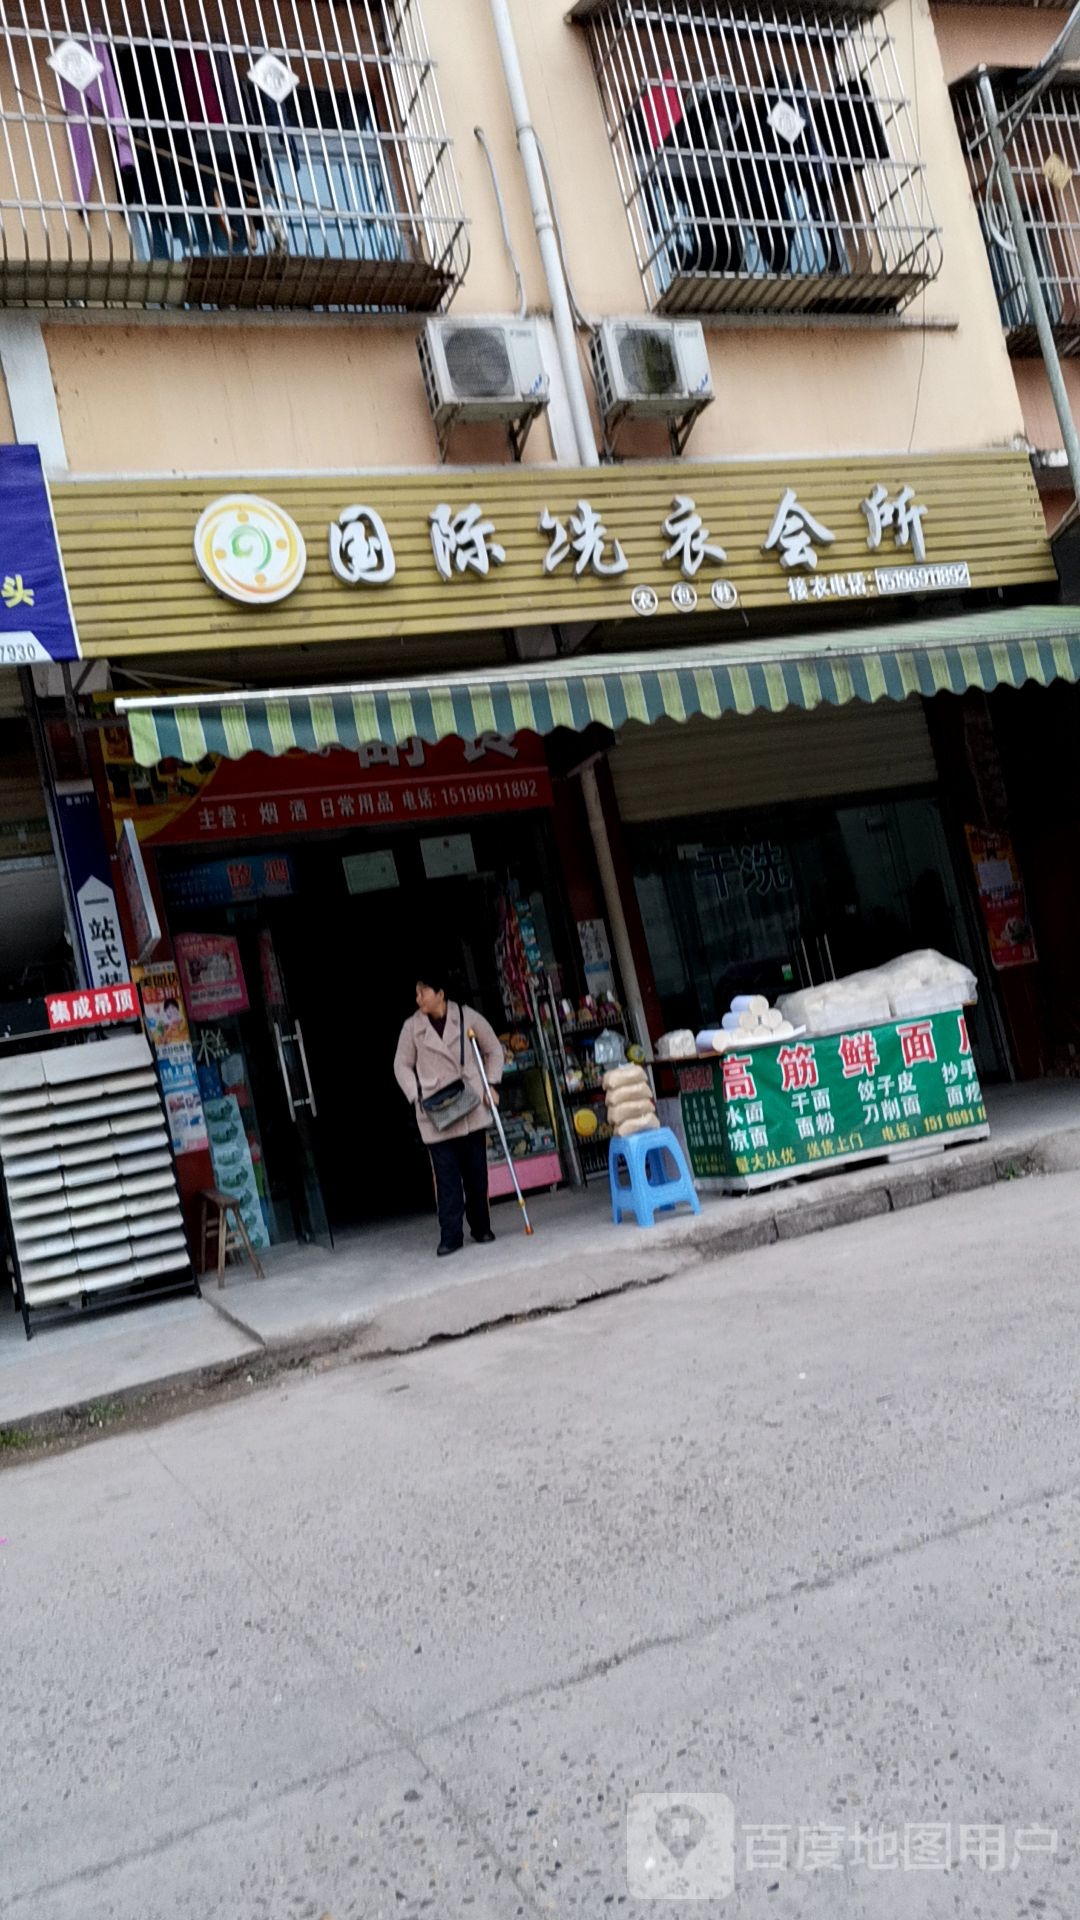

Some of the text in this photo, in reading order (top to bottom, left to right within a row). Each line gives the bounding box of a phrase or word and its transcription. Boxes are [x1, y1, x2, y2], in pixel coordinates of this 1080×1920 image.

[329, 483, 928, 585] 国际洗衣会所
[1, 573, 35, 608] 头
[320, 791, 394, 819] 日常用品
[695, 840, 793, 901] 干洗
[50, 988, 134, 1024] 集成吊顶
[720, 1014, 971, 1103] 高筋鲜面
[726, 1100, 764, 1128] 水面
[858, 1070, 916, 1102] 饺子皮
[795, 1110, 835, 1140] 面粉
[863, 1093, 921, 1125] 刀削面
